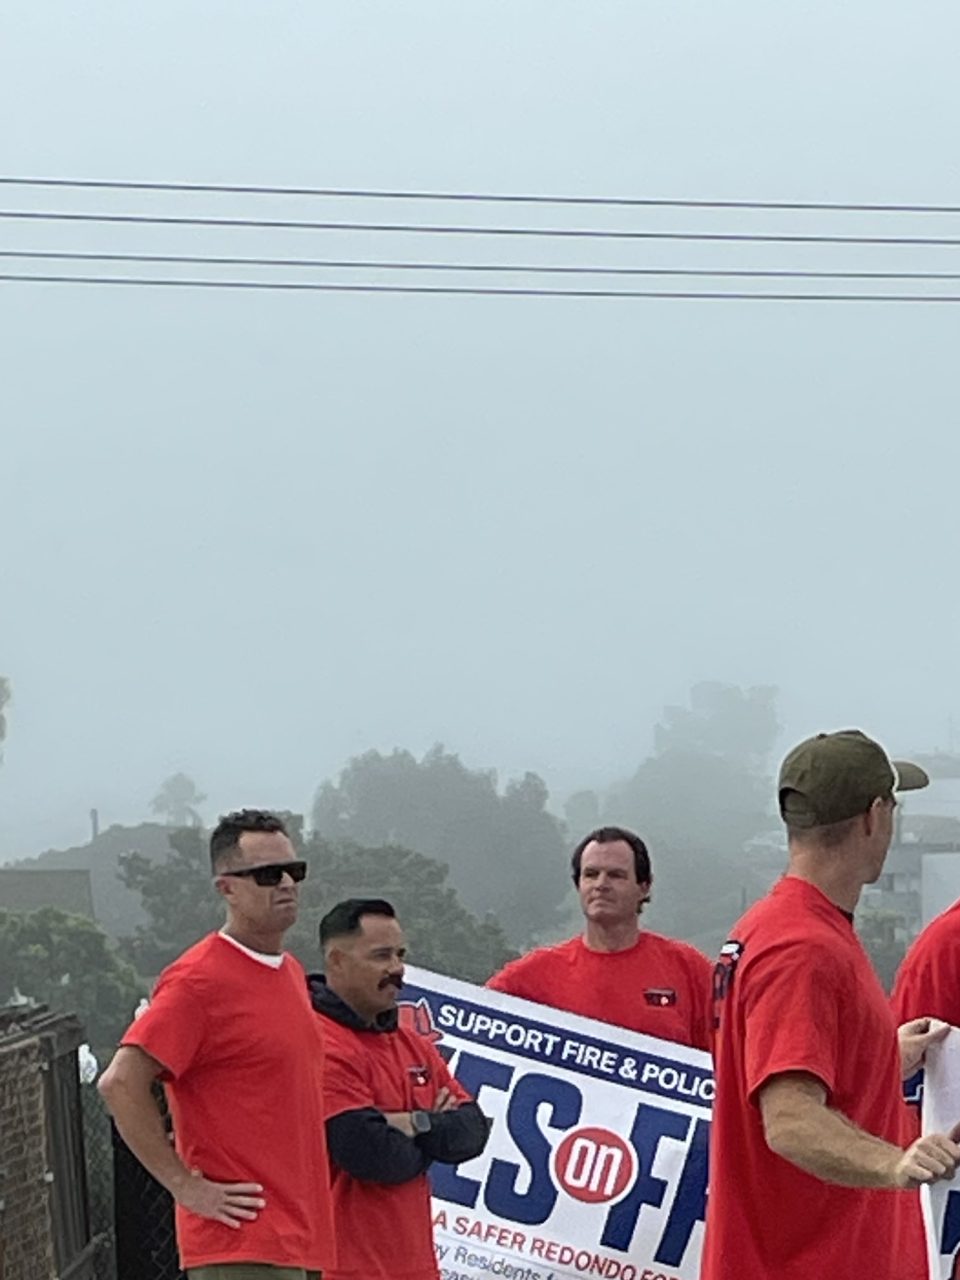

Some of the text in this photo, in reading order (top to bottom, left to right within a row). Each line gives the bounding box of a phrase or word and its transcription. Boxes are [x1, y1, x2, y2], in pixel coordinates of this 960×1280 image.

[437, 1004, 717, 1100] SUPPORT FIRE & POLIC
[428, 1046, 583, 1226] ES
[563, 1137, 623, 1196] on
[433, 1209, 448, 1231] A
[452, 1216, 527, 1252] SAFER
